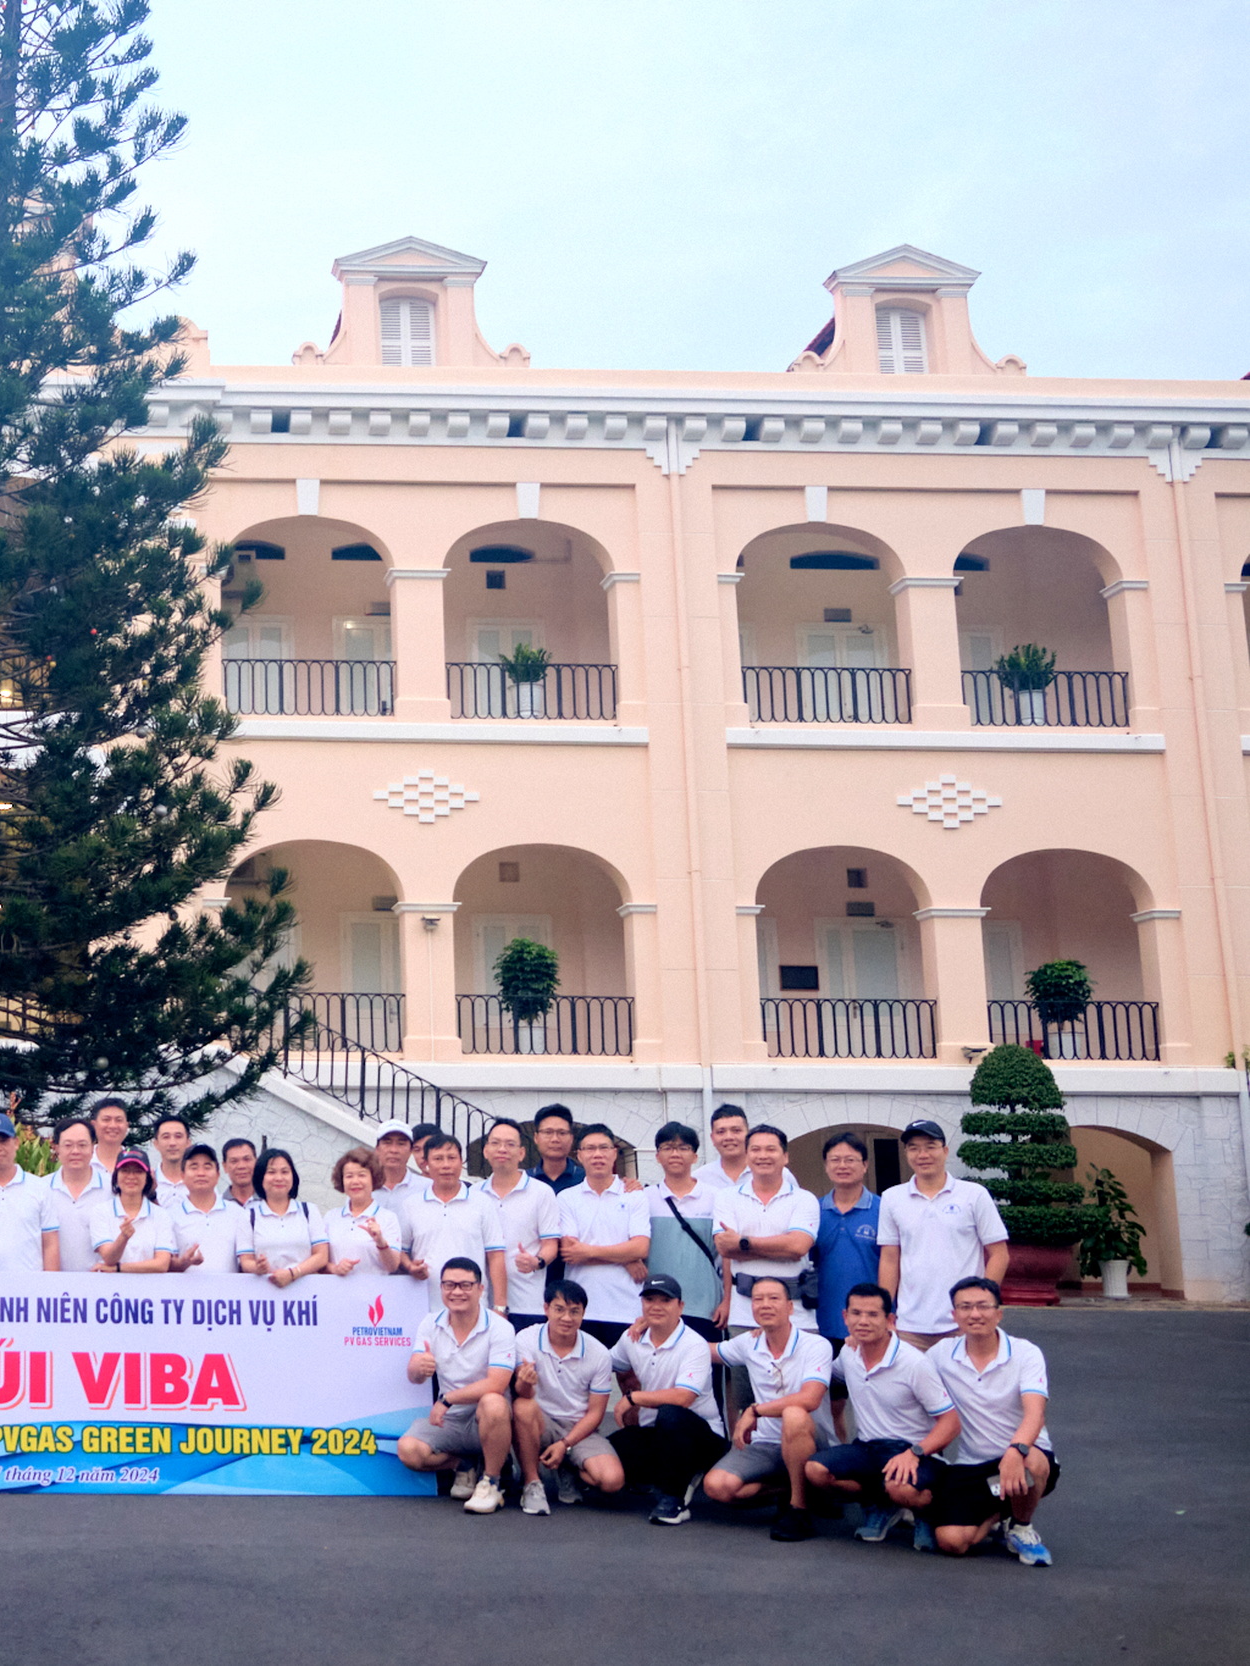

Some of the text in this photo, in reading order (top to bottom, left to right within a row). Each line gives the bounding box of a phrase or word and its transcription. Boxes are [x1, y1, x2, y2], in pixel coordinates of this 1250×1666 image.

[36, 1292, 88, 1324] NIÊN
[95, 1292, 154, 1325] CÔNG
[161, 1299, 184, 1325] TY
[192, 1299, 242, 1332] DỊCH
[248, 1300, 276, 1332] VỤ
[283, 1295, 318, 1327] KHÍ
[344, 1337, 412, 1346] PV GAS SERVICES
[352, 1327, 403, 1336] PETROVIETNAM
[72, 1351, 246, 1411] VIBA
[81, 1427, 172, 1454] GREEN
[179, 1427, 304, 1456] JOURNEY
[311, 1429, 378, 1456] 2024
[5, 1466, 51, 1484] tháng
[56, 1467, 76, 1482] 12
[80, 1467, 115, 1482] năm
[120, 1467, 159, 1482] 2024
